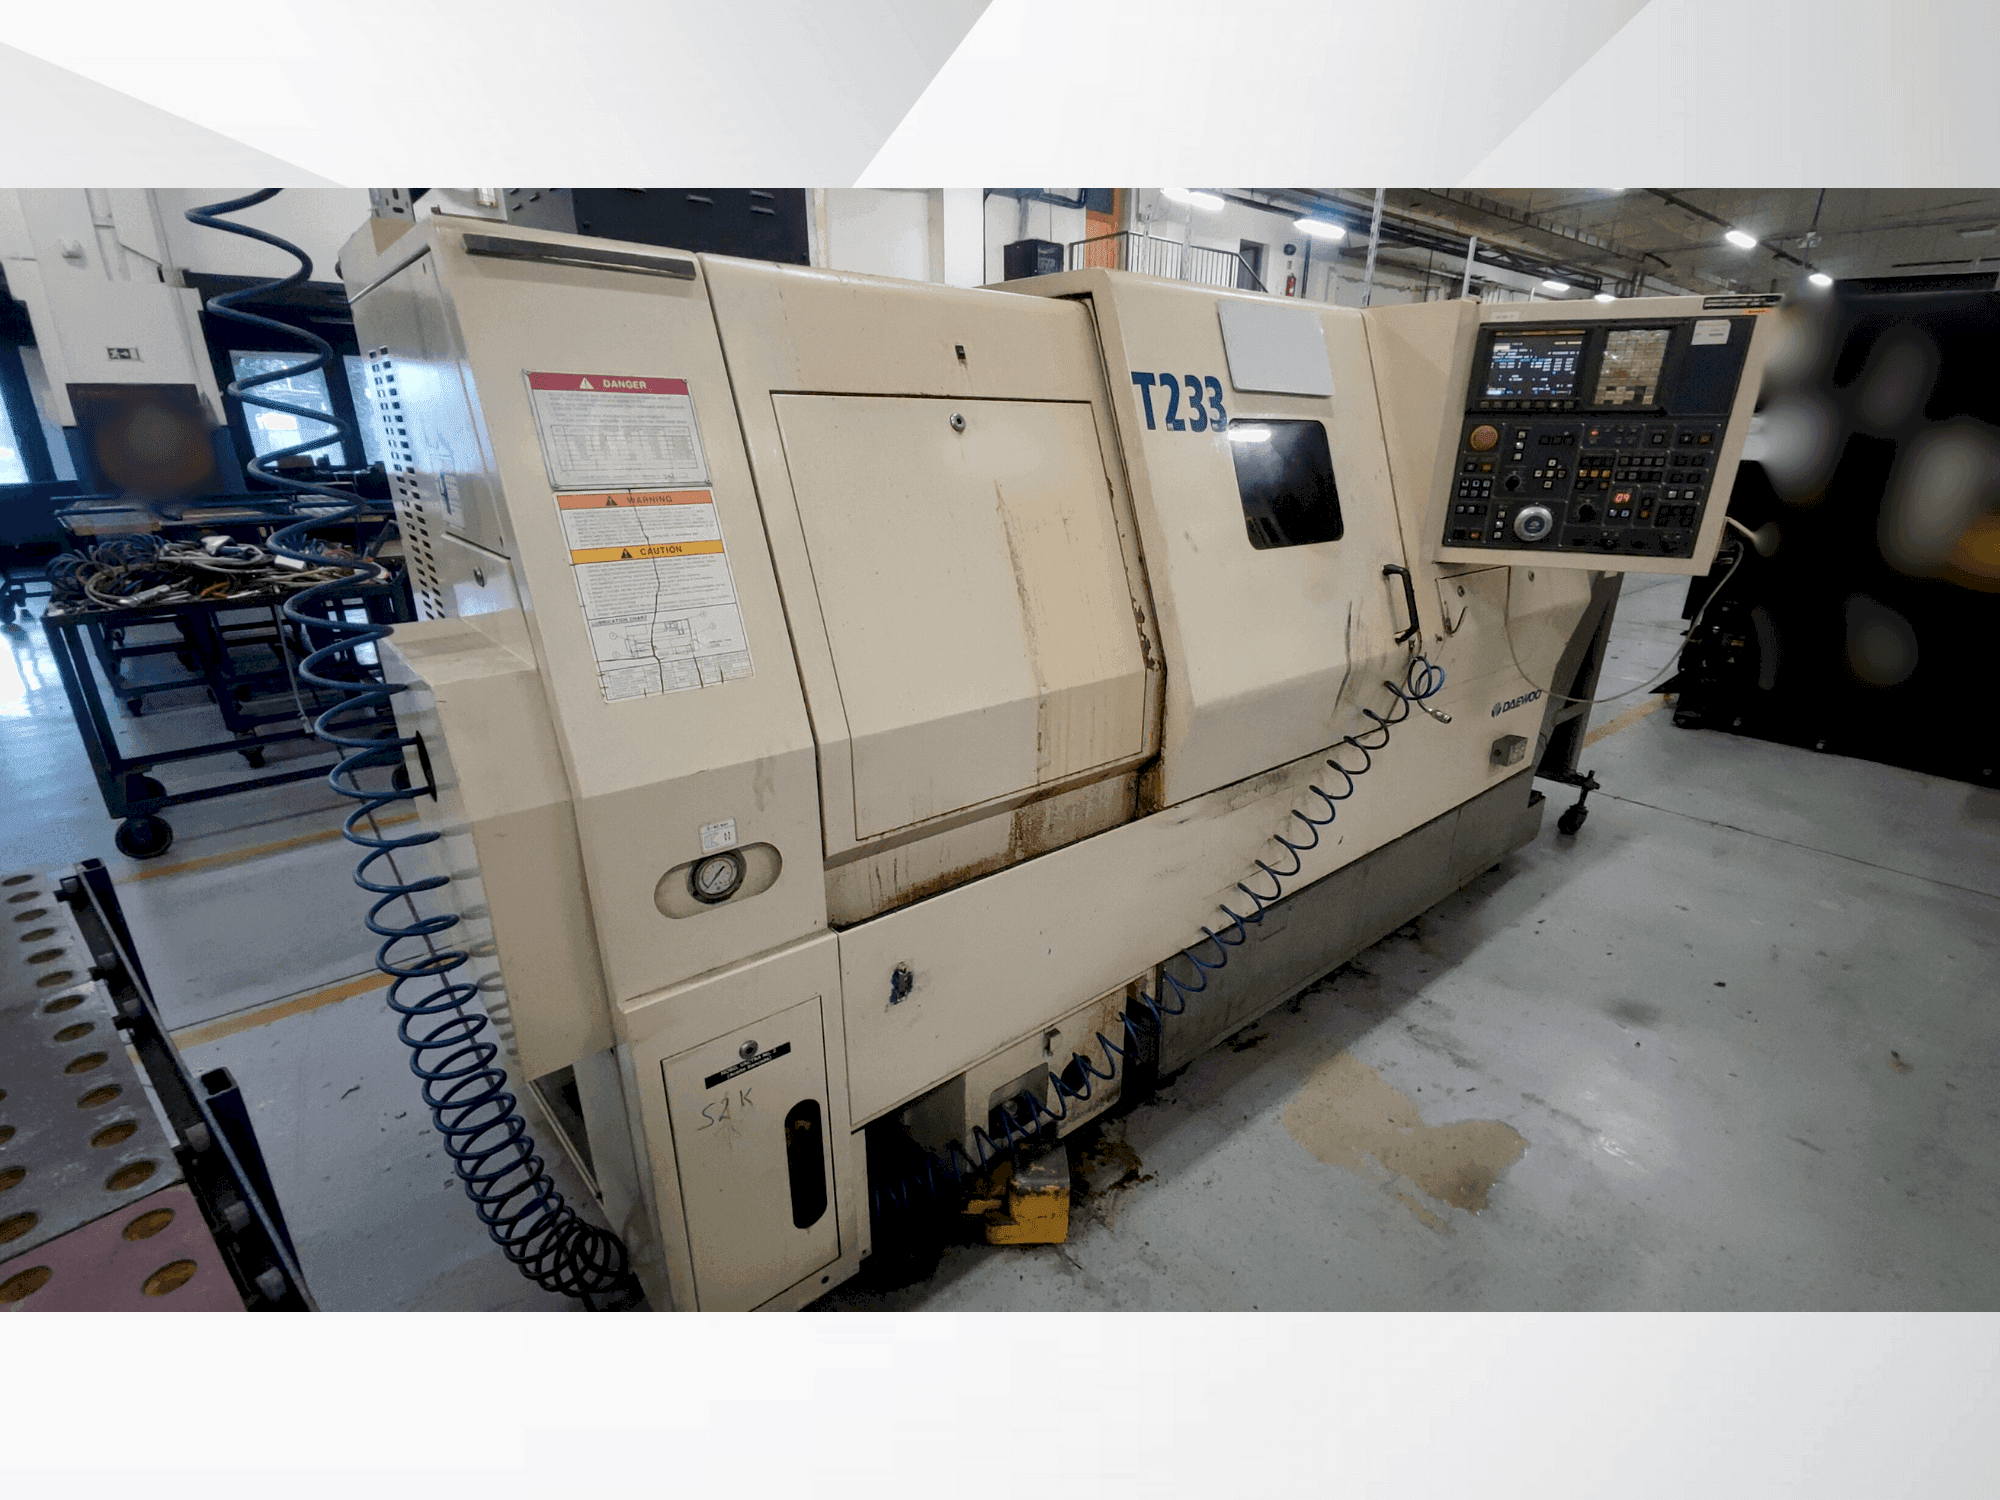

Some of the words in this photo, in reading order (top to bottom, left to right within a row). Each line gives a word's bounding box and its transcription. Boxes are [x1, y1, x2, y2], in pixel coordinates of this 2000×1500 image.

[602, 378, 648, 390] DANGER
[1131, 371, 1228, 433] T233
[626, 494, 673, 504] WARNING
[639, 545, 682, 556] CAUTION
